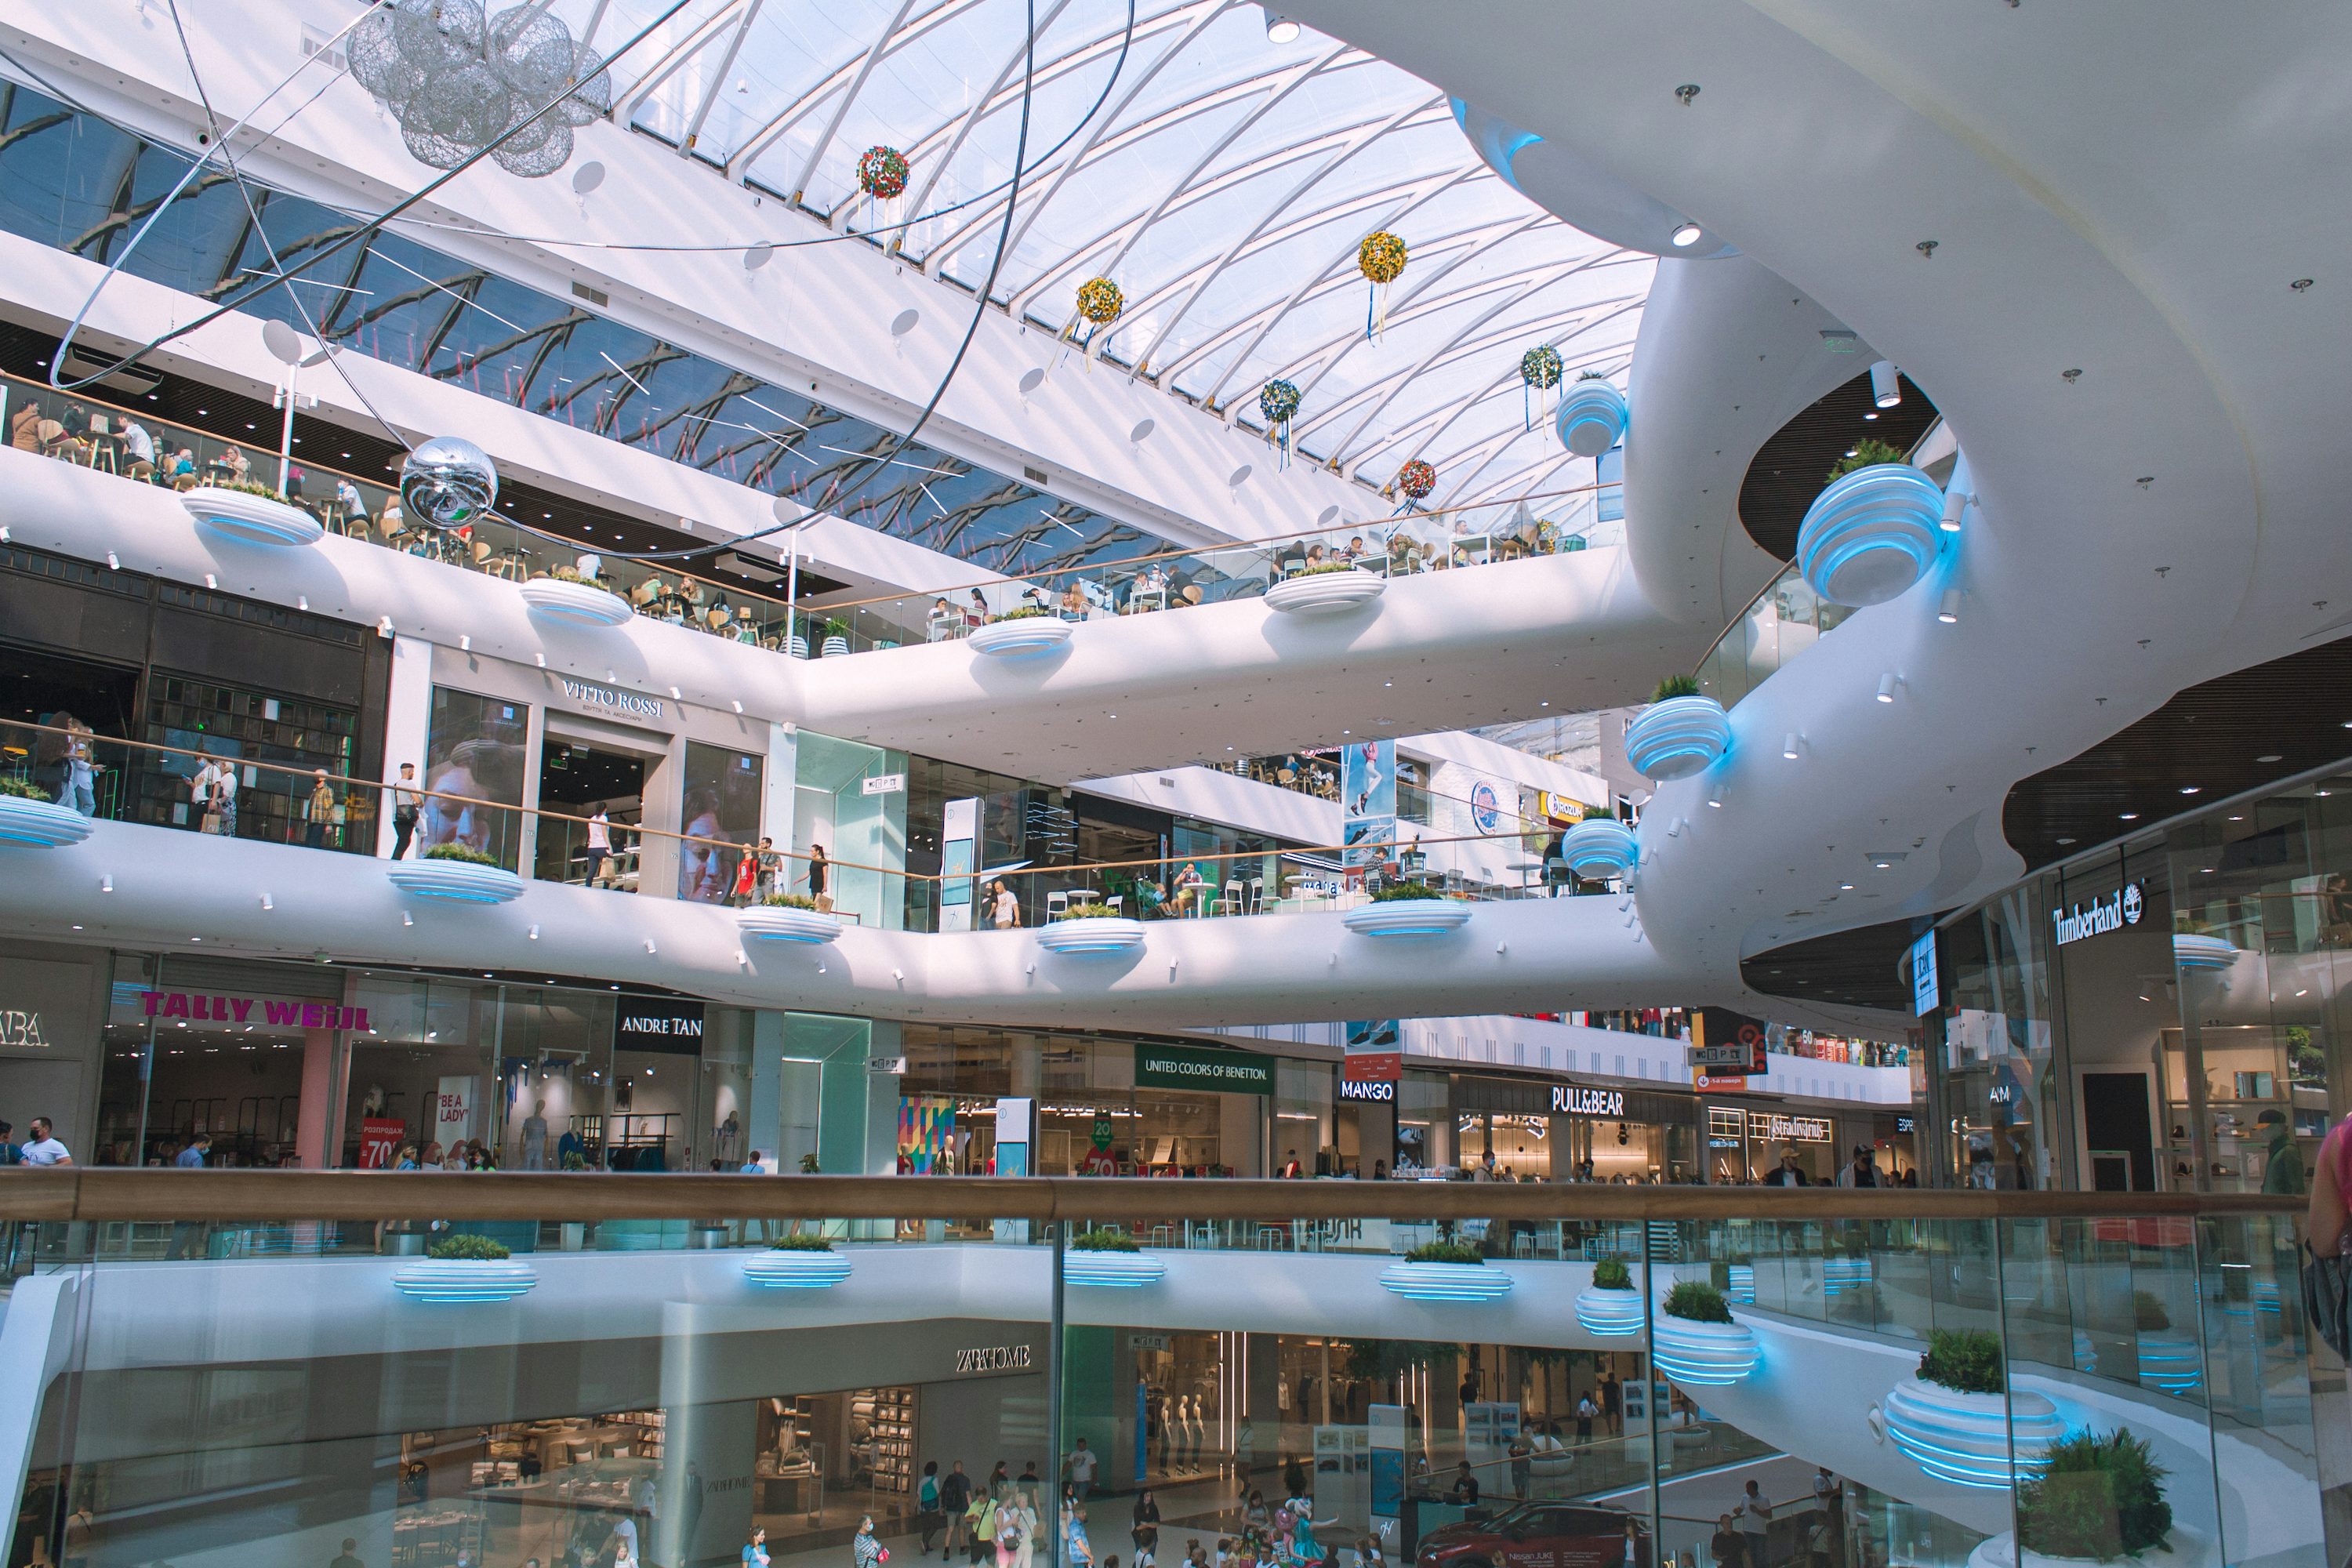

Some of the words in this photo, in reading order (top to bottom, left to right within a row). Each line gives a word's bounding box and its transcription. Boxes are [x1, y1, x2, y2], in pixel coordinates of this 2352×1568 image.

[562, 680, 615, 706] VITTO
[618, 693, 663, 718] ROSSI
[2053, 888, 2122, 946] Timberland
[141, 991, 254, 1022] TALLY
[622, 1016, 669, 1034] ANDRE
[672, 1018, 702, 1036] TAN
[1802, 1029, 1813, 1045] 60
[1145, 1059, 1177, 1073] UNITED
[1178, 1062, 1211, 1076] COLORS
[1213, 1065, 1225, 1077] OF
[1341, 1080, 1393, 1100] MANGO
[1552, 1087, 1624, 1116] PULL&BEAR
[364, 1125, 403, 1134] РОЗПРОДАЖ
[1095, 1122, 1110, 1136] 20
[368, 1140, 396, 1168] 70
